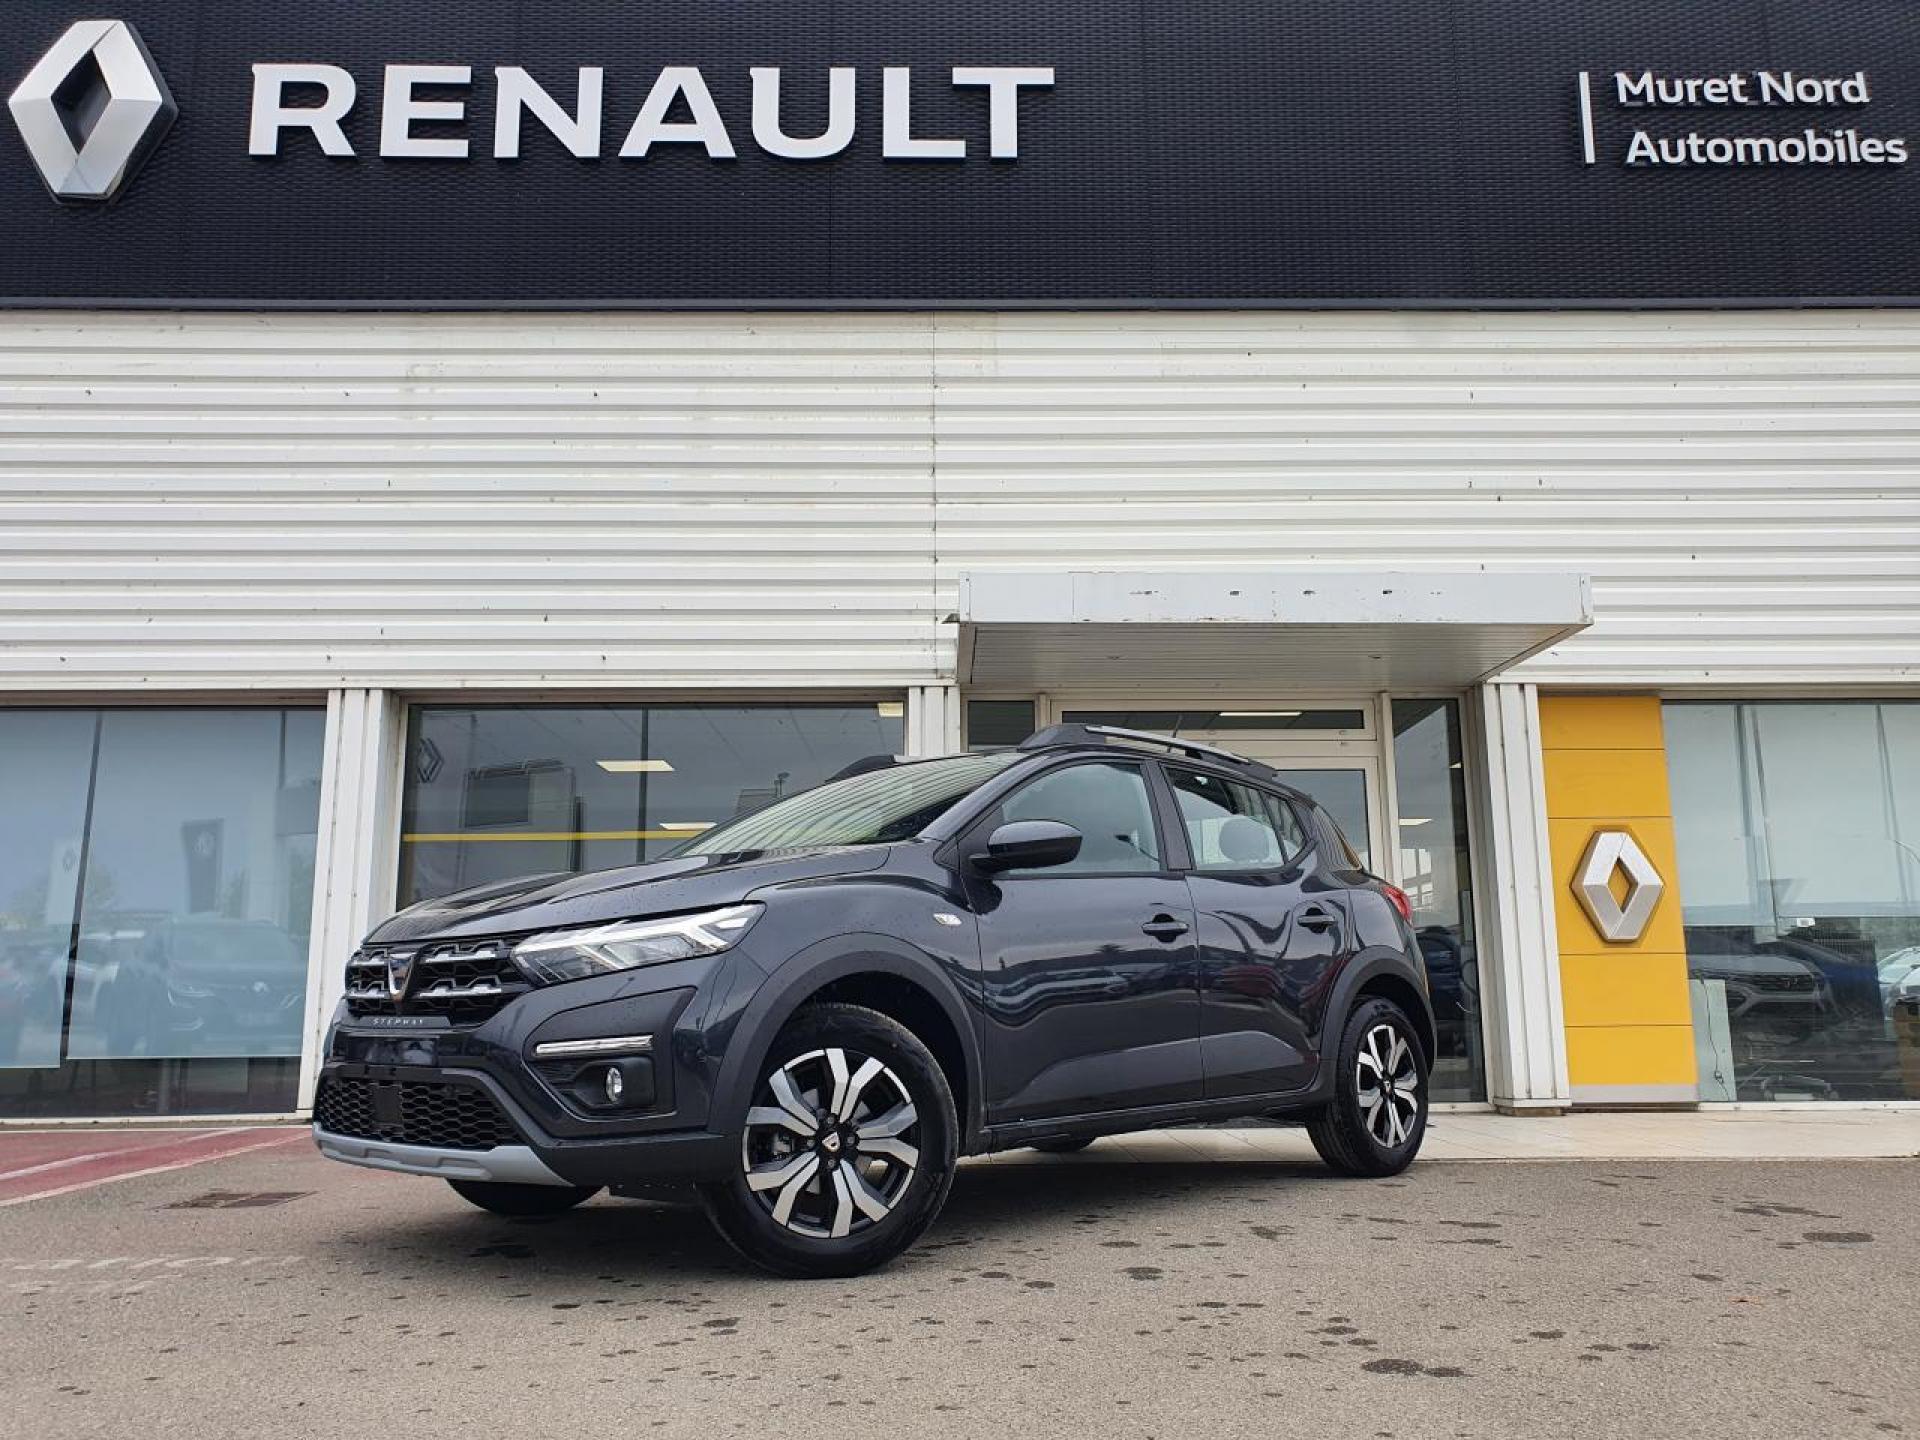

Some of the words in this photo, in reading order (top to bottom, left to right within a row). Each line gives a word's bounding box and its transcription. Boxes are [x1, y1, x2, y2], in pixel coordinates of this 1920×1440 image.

[1615, 71, 1748, 103] Muret
[1756, 71, 1870, 103] Nord
[248, 63, 1055, 160] RENAULT
[1626, 129, 1908, 164] Automobiles
